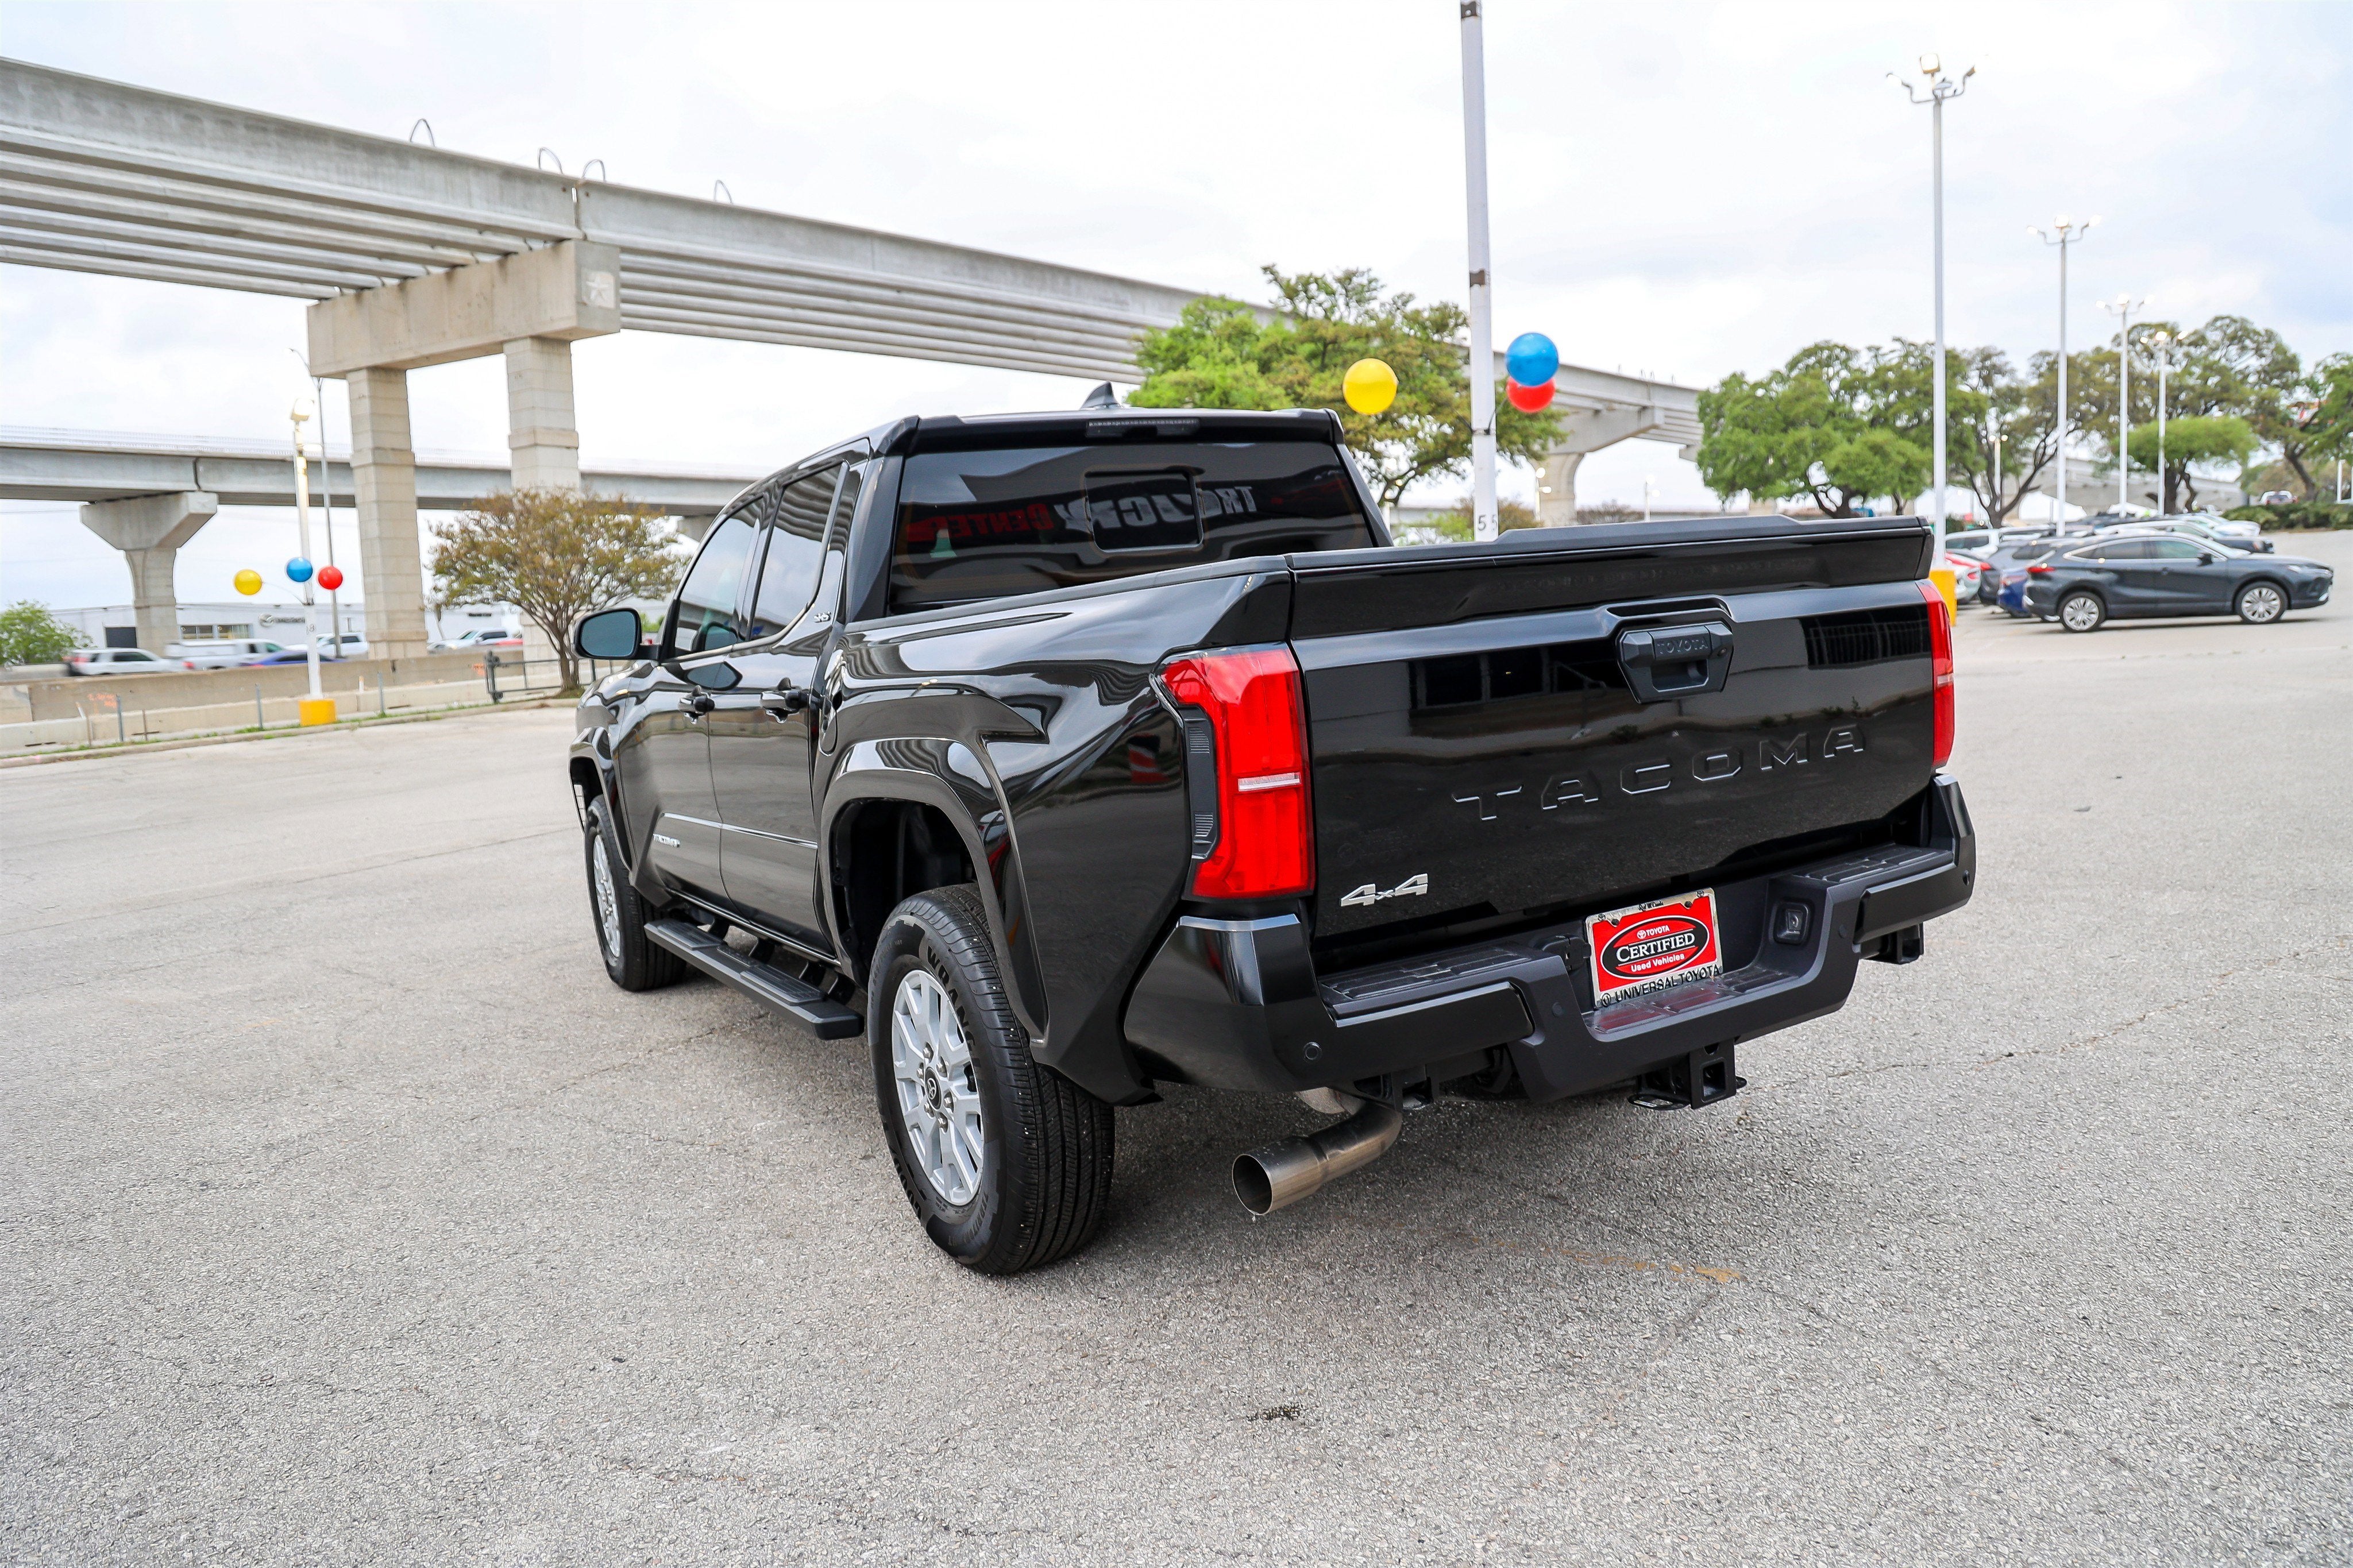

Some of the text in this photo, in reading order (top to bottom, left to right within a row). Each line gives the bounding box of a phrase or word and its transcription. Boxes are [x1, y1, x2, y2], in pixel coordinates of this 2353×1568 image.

[1656, 636, 1709, 655] TOYOTA
[1451, 723, 1866, 821] TACOMA
[1646, 925, 1670, 936] TOYOTA
[1616, 933, 1695, 962] CERTIFIED
[1630, 953, 1685, 972] Used Vehicles
[1615, 964, 1721, 1002] UNIVERSAL TOYOTA
